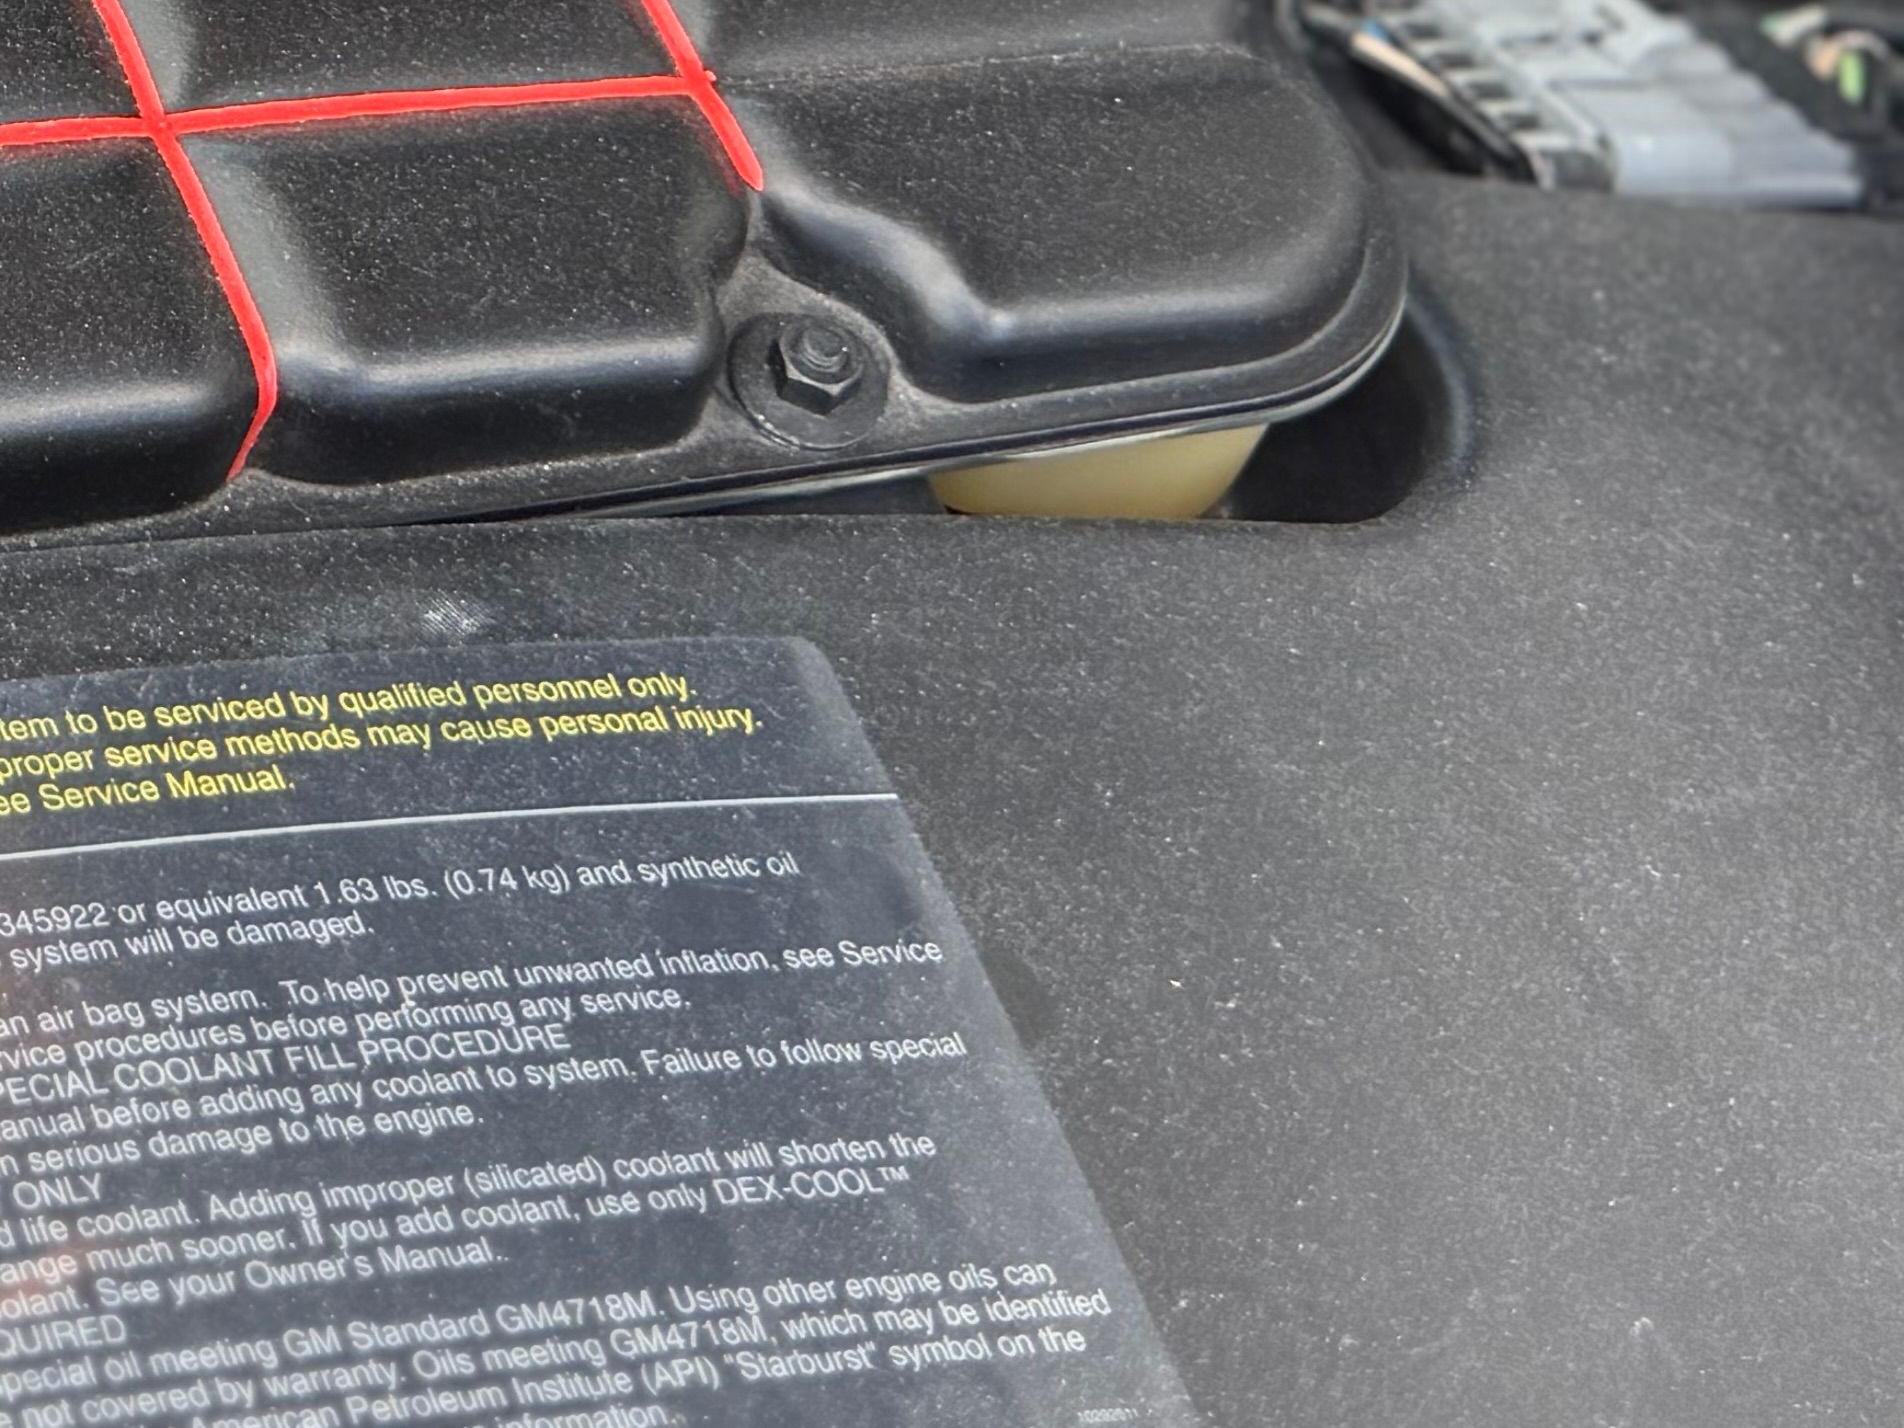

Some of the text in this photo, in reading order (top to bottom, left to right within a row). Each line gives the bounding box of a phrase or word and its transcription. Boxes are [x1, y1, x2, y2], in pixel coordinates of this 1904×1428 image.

[62, 711, 101, 736] to
[102, 705, 150, 732] be
[152, 693, 288, 728] serviced
[288, 691, 337, 723] by
[336, 681, 469, 721] qualified
[471, 672, 624, 712] personnel
[624, 670, 700, 702] only.
[101, 736, 220, 768] service
[223, 723, 363, 757] methods
[365, 723, 439, 751] may
[437, 718, 535, 742] cause
[537, 705, 671, 743] personal
[670, 703, 766, 735] injury.
[36, 777, 162, 809] Service
[162, 763, 296, 798] Manual.
[115, 903, 151, 924] or
[153, 885, 310, 925] equivalent
[311, 878, 381, 906] 1.63
[381, 875, 439, 901] lbs.
[440, 868, 521, 902] (0.74
[521, 864, 575, 896] kg)
[575, 861, 637, 887] and
[636, 855, 765, 889] synthetic
[764, 853, 802, 877] oil
[7, 938, 119, 972] system
[122, 927, 175, 955] will
[177, 924, 221, 950] be
[222, 910, 375, 945] damaged.
[34, 1003, 79, 1030] air
[80, 999, 147, 1027] bag
[149, 989, 268, 1023] system.
[280, 979, 325, 1005] To
[322, 973, 395, 1003] help
[395, 964, 509, 1001] prevent
[512, 953, 655, 985] unwanted
[655, 948, 781, 975] inflation,
[780, 948, 837, 968] see
[836, 939, 945, 965] Service
[72, 1024, 248, 1067] procedures
[249, 1013, 350, 1041] before
[353, 998, 517, 1038] performing
[517, 996, 579, 1021] any
[578, 985, 692, 1013] service.
[108, 1049, 281, 1090] COOLANT
[282, 1041, 357, 1071] FILL
[355, 1023, 572, 1064] PROCEDURE
[88, 1099, 194, 1128] before
[194, 1086, 307, 1117] adding
[308, 1082, 369, 1108] any
[369, 1067, 484, 1099] coolant
[484, 1065, 520, 1088] to
[522, 1059, 638, 1090] system.
[638, 1049, 745, 1075] Failure
[744, 1046, 780, 1068] to
[778, 1041, 867, 1066] follow
[867, 1033, 969, 1066] special
[24, 1137, 142, 1168] serious
[142, 1122, 274, 1154] damage
[276, 1116, 311, 1139] to
[308, 1109, 367, 1136] the
[369, 1100, 483, 1133] engine.
[8, 1170, 109, 1206] ONLY
[18, 1213, 69, 1240] life
[73, 1198, 199, 1233] coolant.
[201, 1186, 317, 1218] Adding
[317, 1173, 459, 1207] improper
[458, 1153, 610, 1196] (silicated)
[609, 1146, 721, 1176] coolant
[722, 1141, 773, 1167] will
[775, 1136, 888, 1163] shorten
[885, 1131, 938, 1155] the
[84, 1234, 174, 1268] much
[178, 1226, 296, 1256] sooner.
[299, 1216, 325, 1242] If
[329, 1215, 389, 1246] you
[392, 1203, 455, 1232] add
[457, 1193, 580, 1225] coolant,
[582, 1191, 643, 1213] use
[643, 1181, 712, 1211] only
